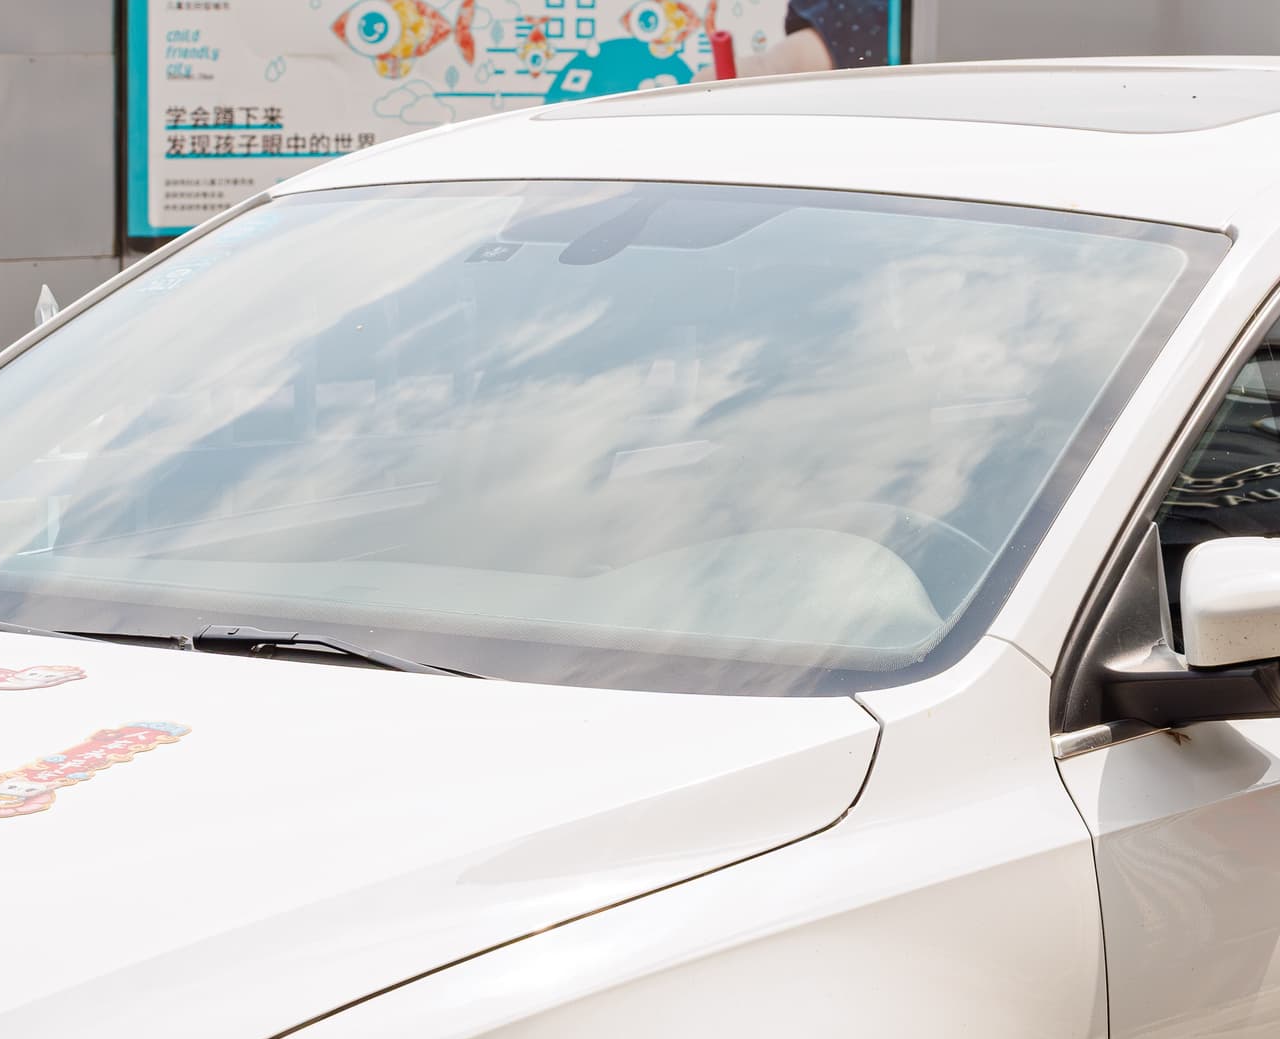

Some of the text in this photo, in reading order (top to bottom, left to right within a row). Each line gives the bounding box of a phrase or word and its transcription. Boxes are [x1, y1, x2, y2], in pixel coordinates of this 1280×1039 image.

[166, 106, 283, 127] 学会蹲下来
[166, 133, 375, 154] 发现孩子眼中的世界
